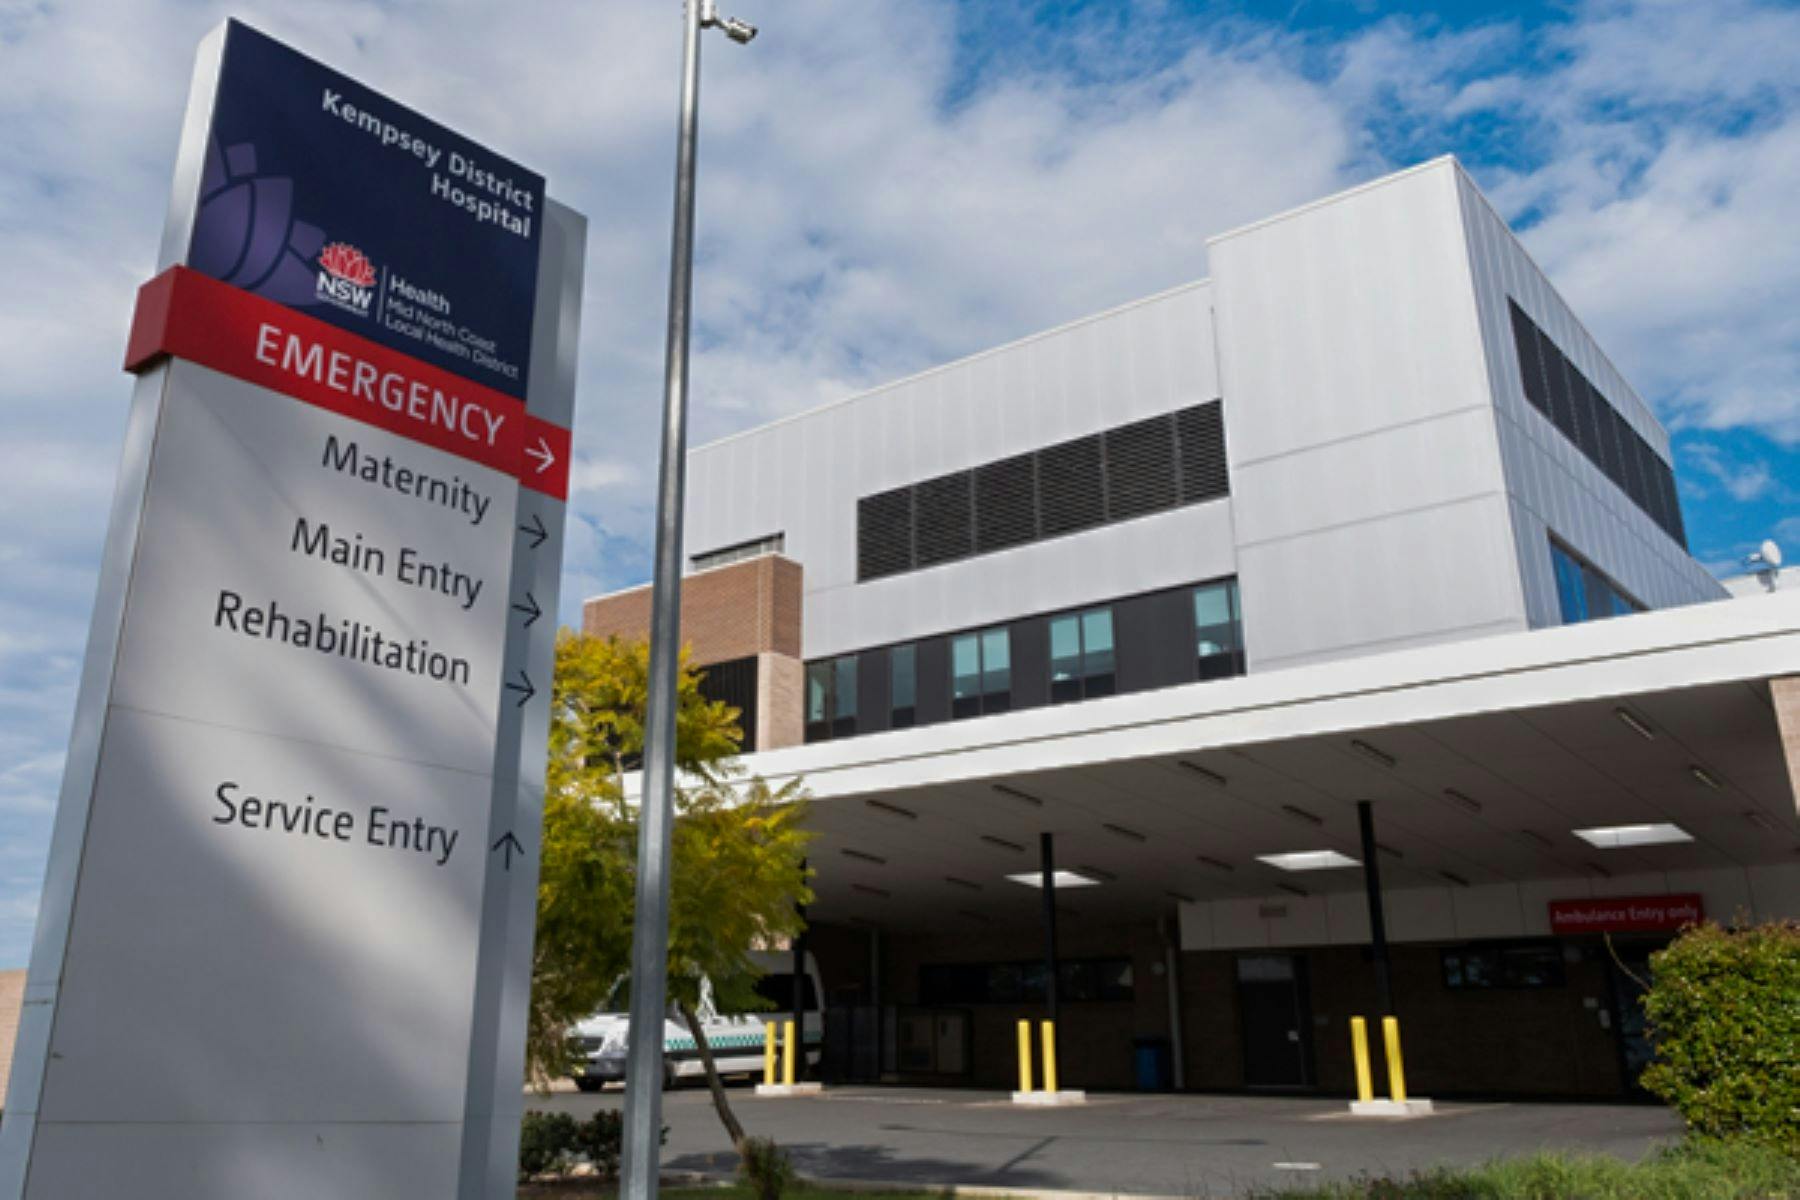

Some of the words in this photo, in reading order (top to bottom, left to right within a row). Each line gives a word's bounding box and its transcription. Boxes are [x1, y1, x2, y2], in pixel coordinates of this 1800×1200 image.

[322, 88, 441, 168] Kempsey
[449, 151, 533, 212] District
[430, 172, 531, 238] Hospital
[316, 271, 372, 309] NSW
[387, 297, 413, 320] Mid
[415, 309, 456, 337] North
[457, 324, 496, 354] Coast
[390, 274, 450, 314] Health
[255, 322, 504, 446] EMERGENCY
[385, 313, 423, 340] Local
[425, 330, 471, 359] Health
[472, 349, 519, 380] District
[322, 434, 490, 525] Maternity
[291, 517, 385, 576] Main
[399, 547, 483, 609] Entry
[214, 589, 470, 685] Rehabilitation
[213, 781, 354, 841] Service
[367, 806, 459, 866] Entry
[1554, 908, 1625, 925] Ambulance
[1628, 905, 1664, 923] Entry
[1667, 904, 1698, 921] only
